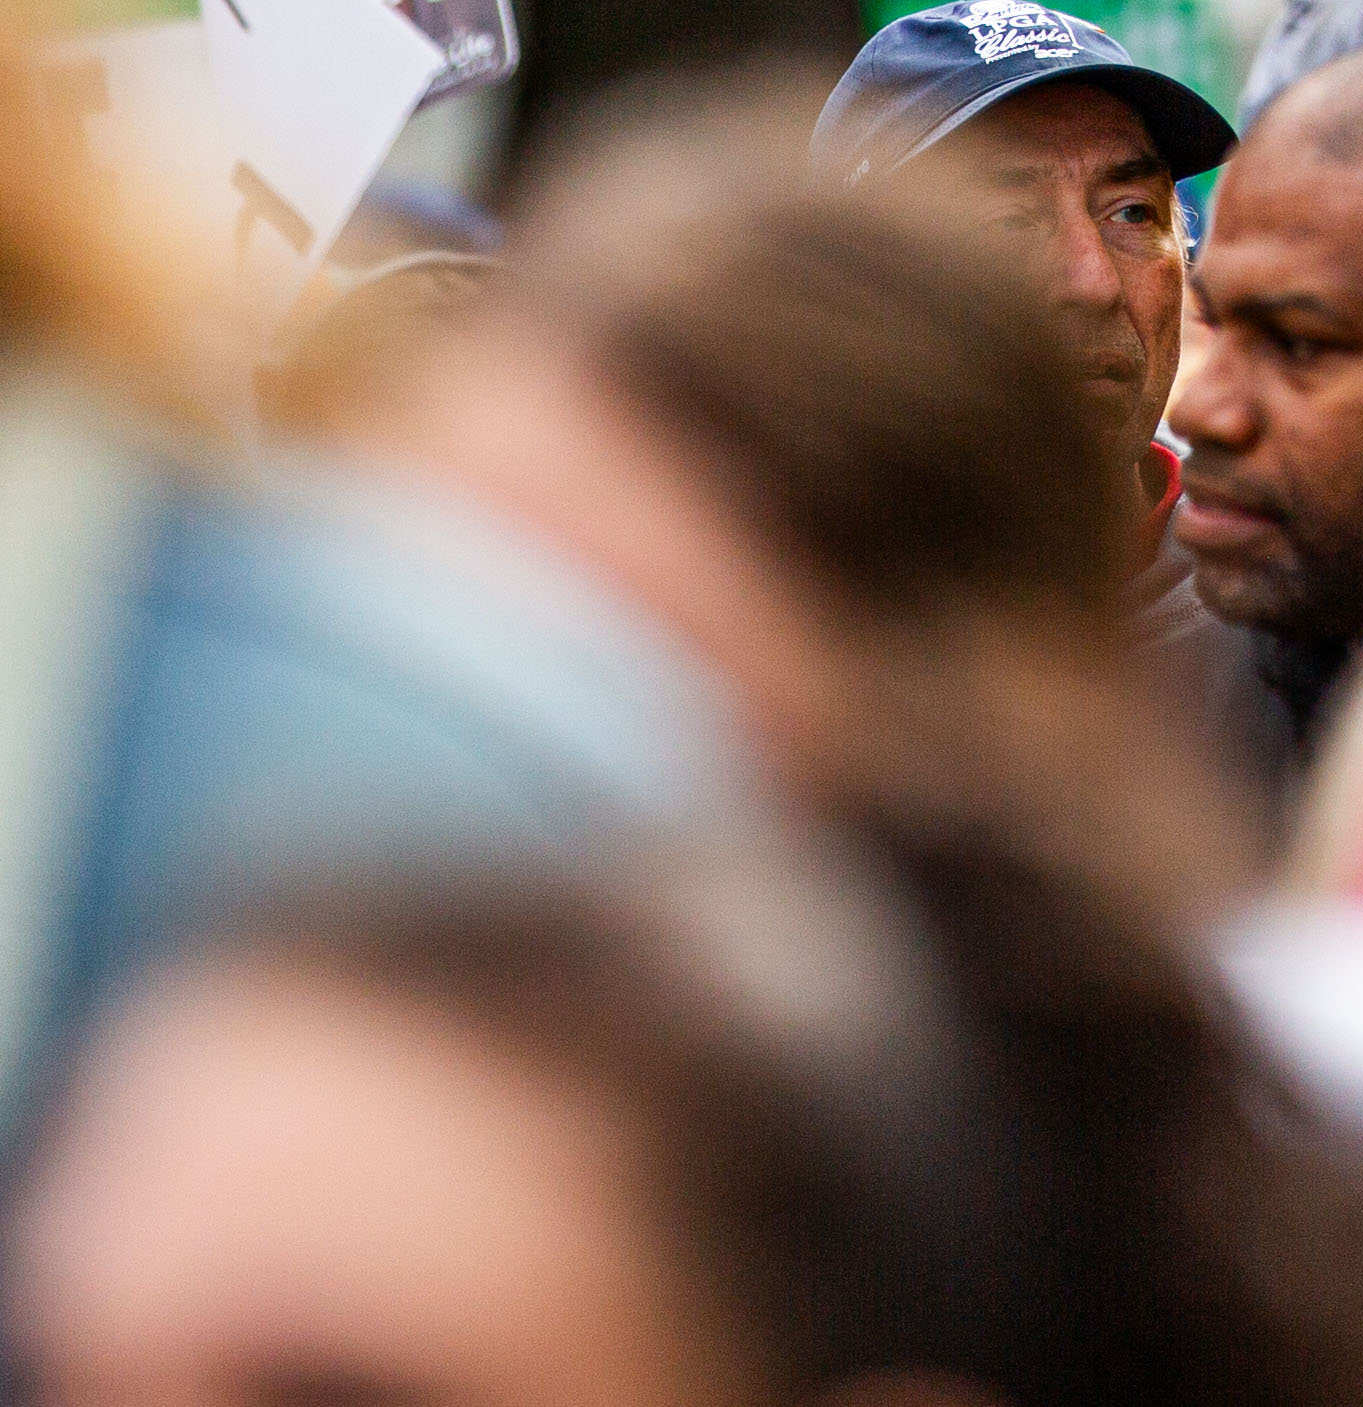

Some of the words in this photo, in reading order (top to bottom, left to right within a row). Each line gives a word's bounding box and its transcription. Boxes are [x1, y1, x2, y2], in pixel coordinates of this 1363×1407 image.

[968, 11, 1059, 44] LPGA
[974, 28, 1073, 60] Classic
[1034, 48, 1079, 60] acer
